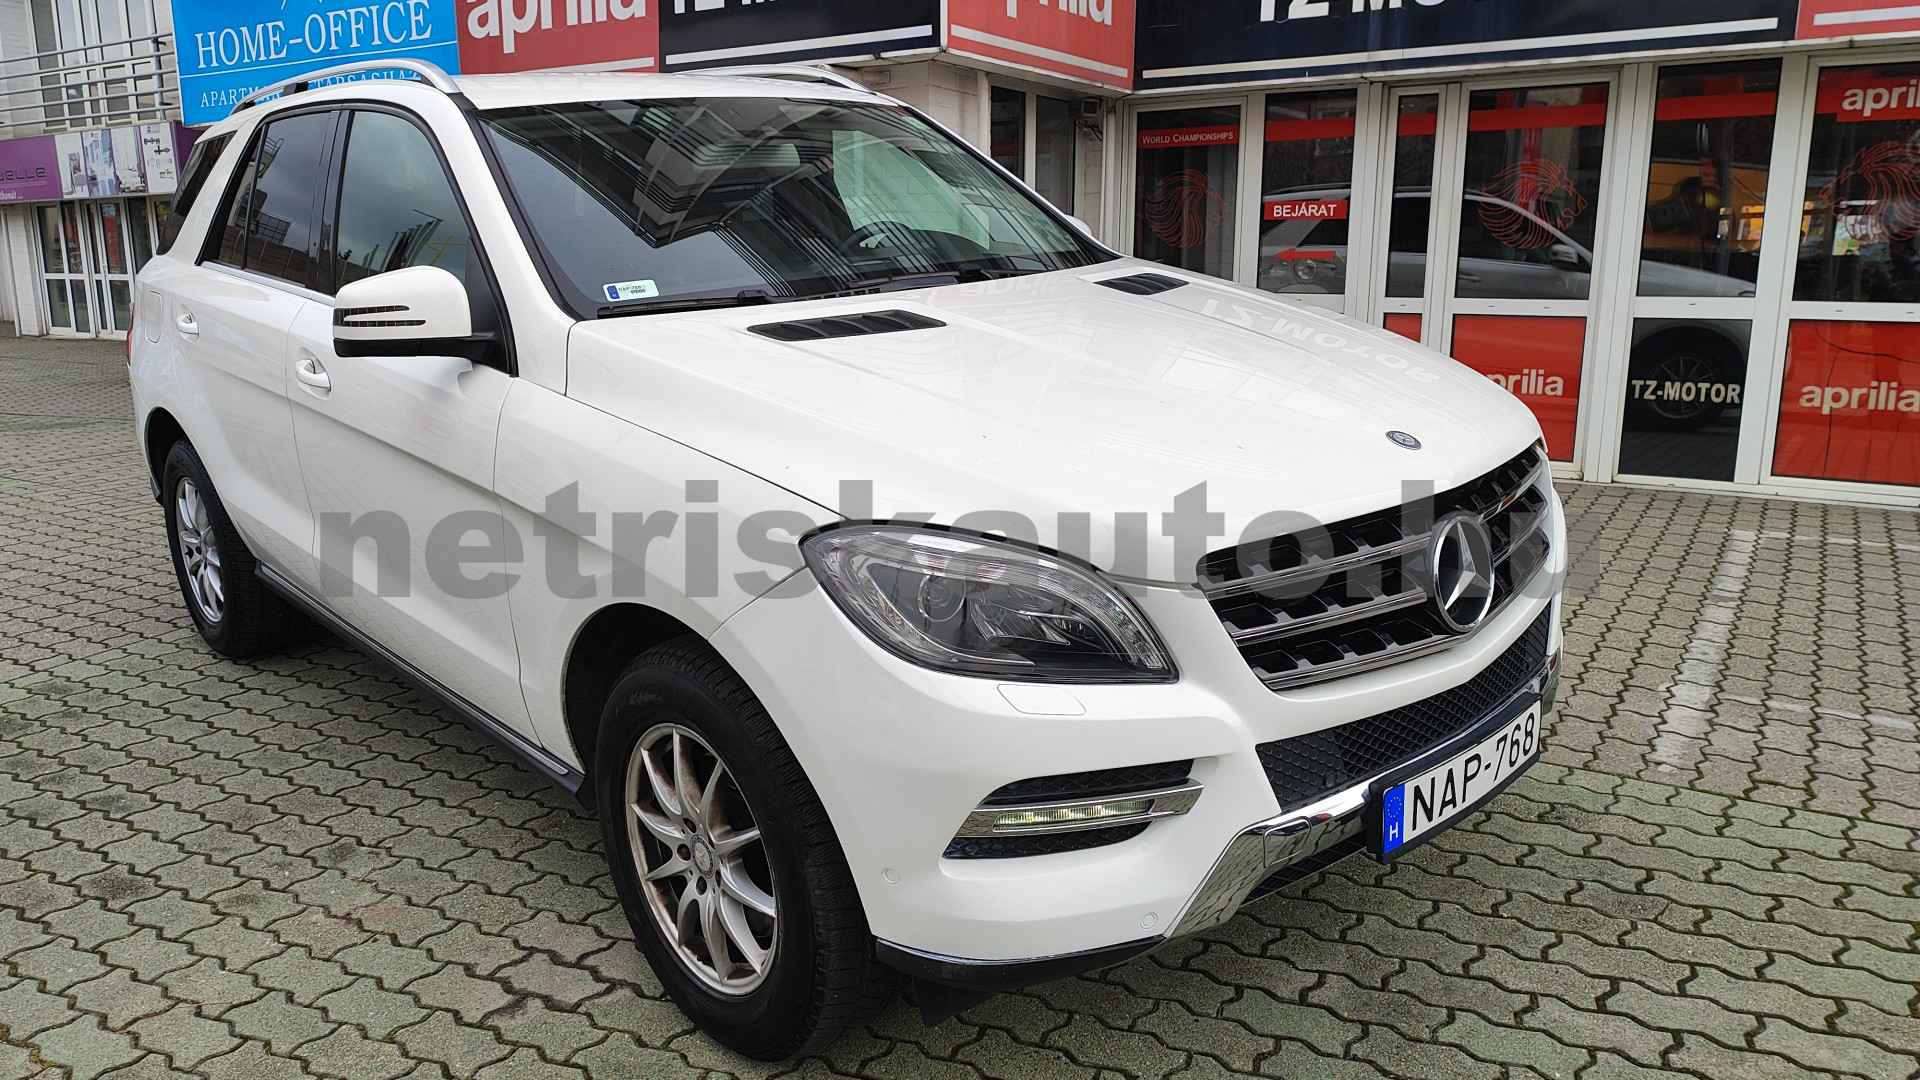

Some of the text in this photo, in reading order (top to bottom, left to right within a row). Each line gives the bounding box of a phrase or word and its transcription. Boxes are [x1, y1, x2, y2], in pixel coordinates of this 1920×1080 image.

[195, 0, 432, 68] HOME-OFFICE
[1142, 131, 1234, 144] WORLD CHAMPIONSHIPS
[1273, 202, 1337, 218] BEJÁRAT
[1631, 379, 1741, 404] TZ-MOTOR
[1800, 380, 1920, 415] aprilia
[1412, 712, 1535, 831] NAP-768
[1389, 822, 1398, 842] H
